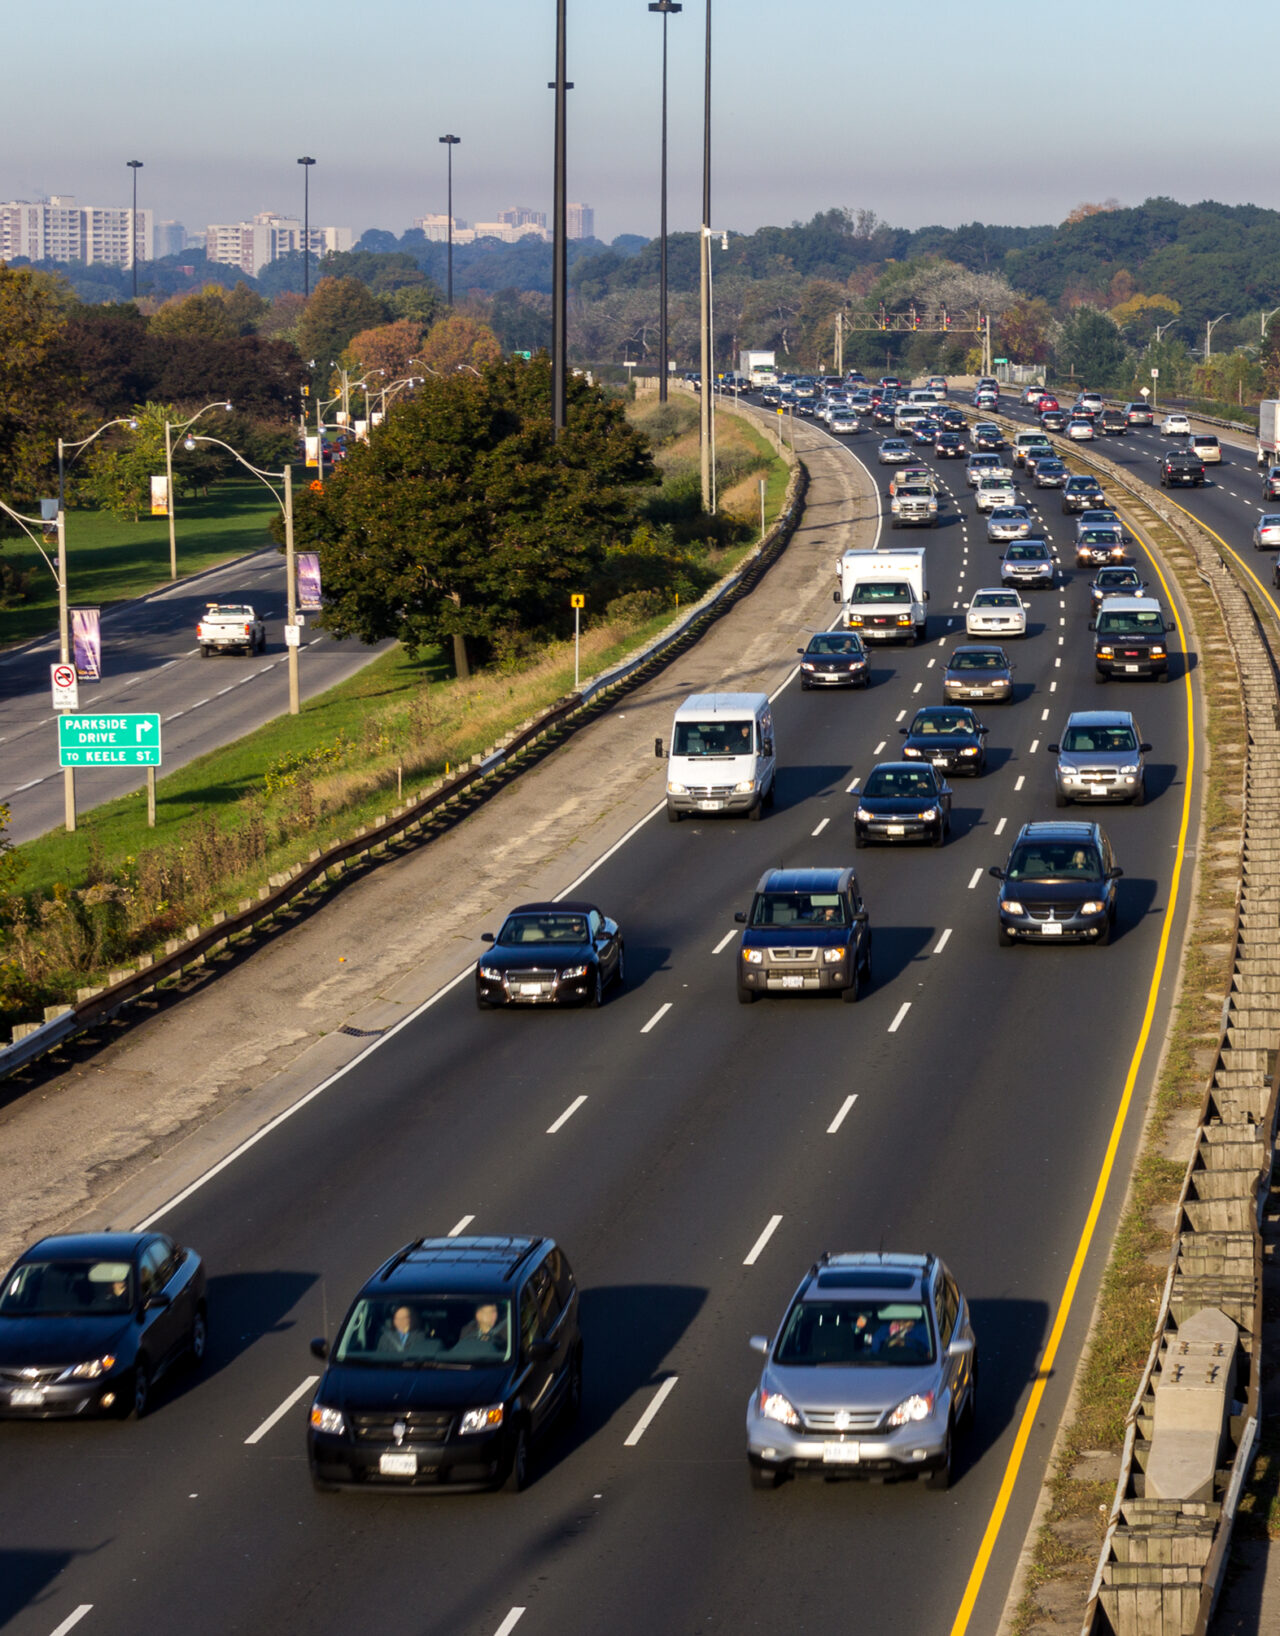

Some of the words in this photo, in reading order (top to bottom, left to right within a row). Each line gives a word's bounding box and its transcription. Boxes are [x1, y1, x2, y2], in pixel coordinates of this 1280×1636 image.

[65, 719, 127, 729] PARKSIDE
[79, 733, 116, 742] DRIVE
[86, 751, 126, 761] KEELE
[136, 751, 154, 761] ST.
